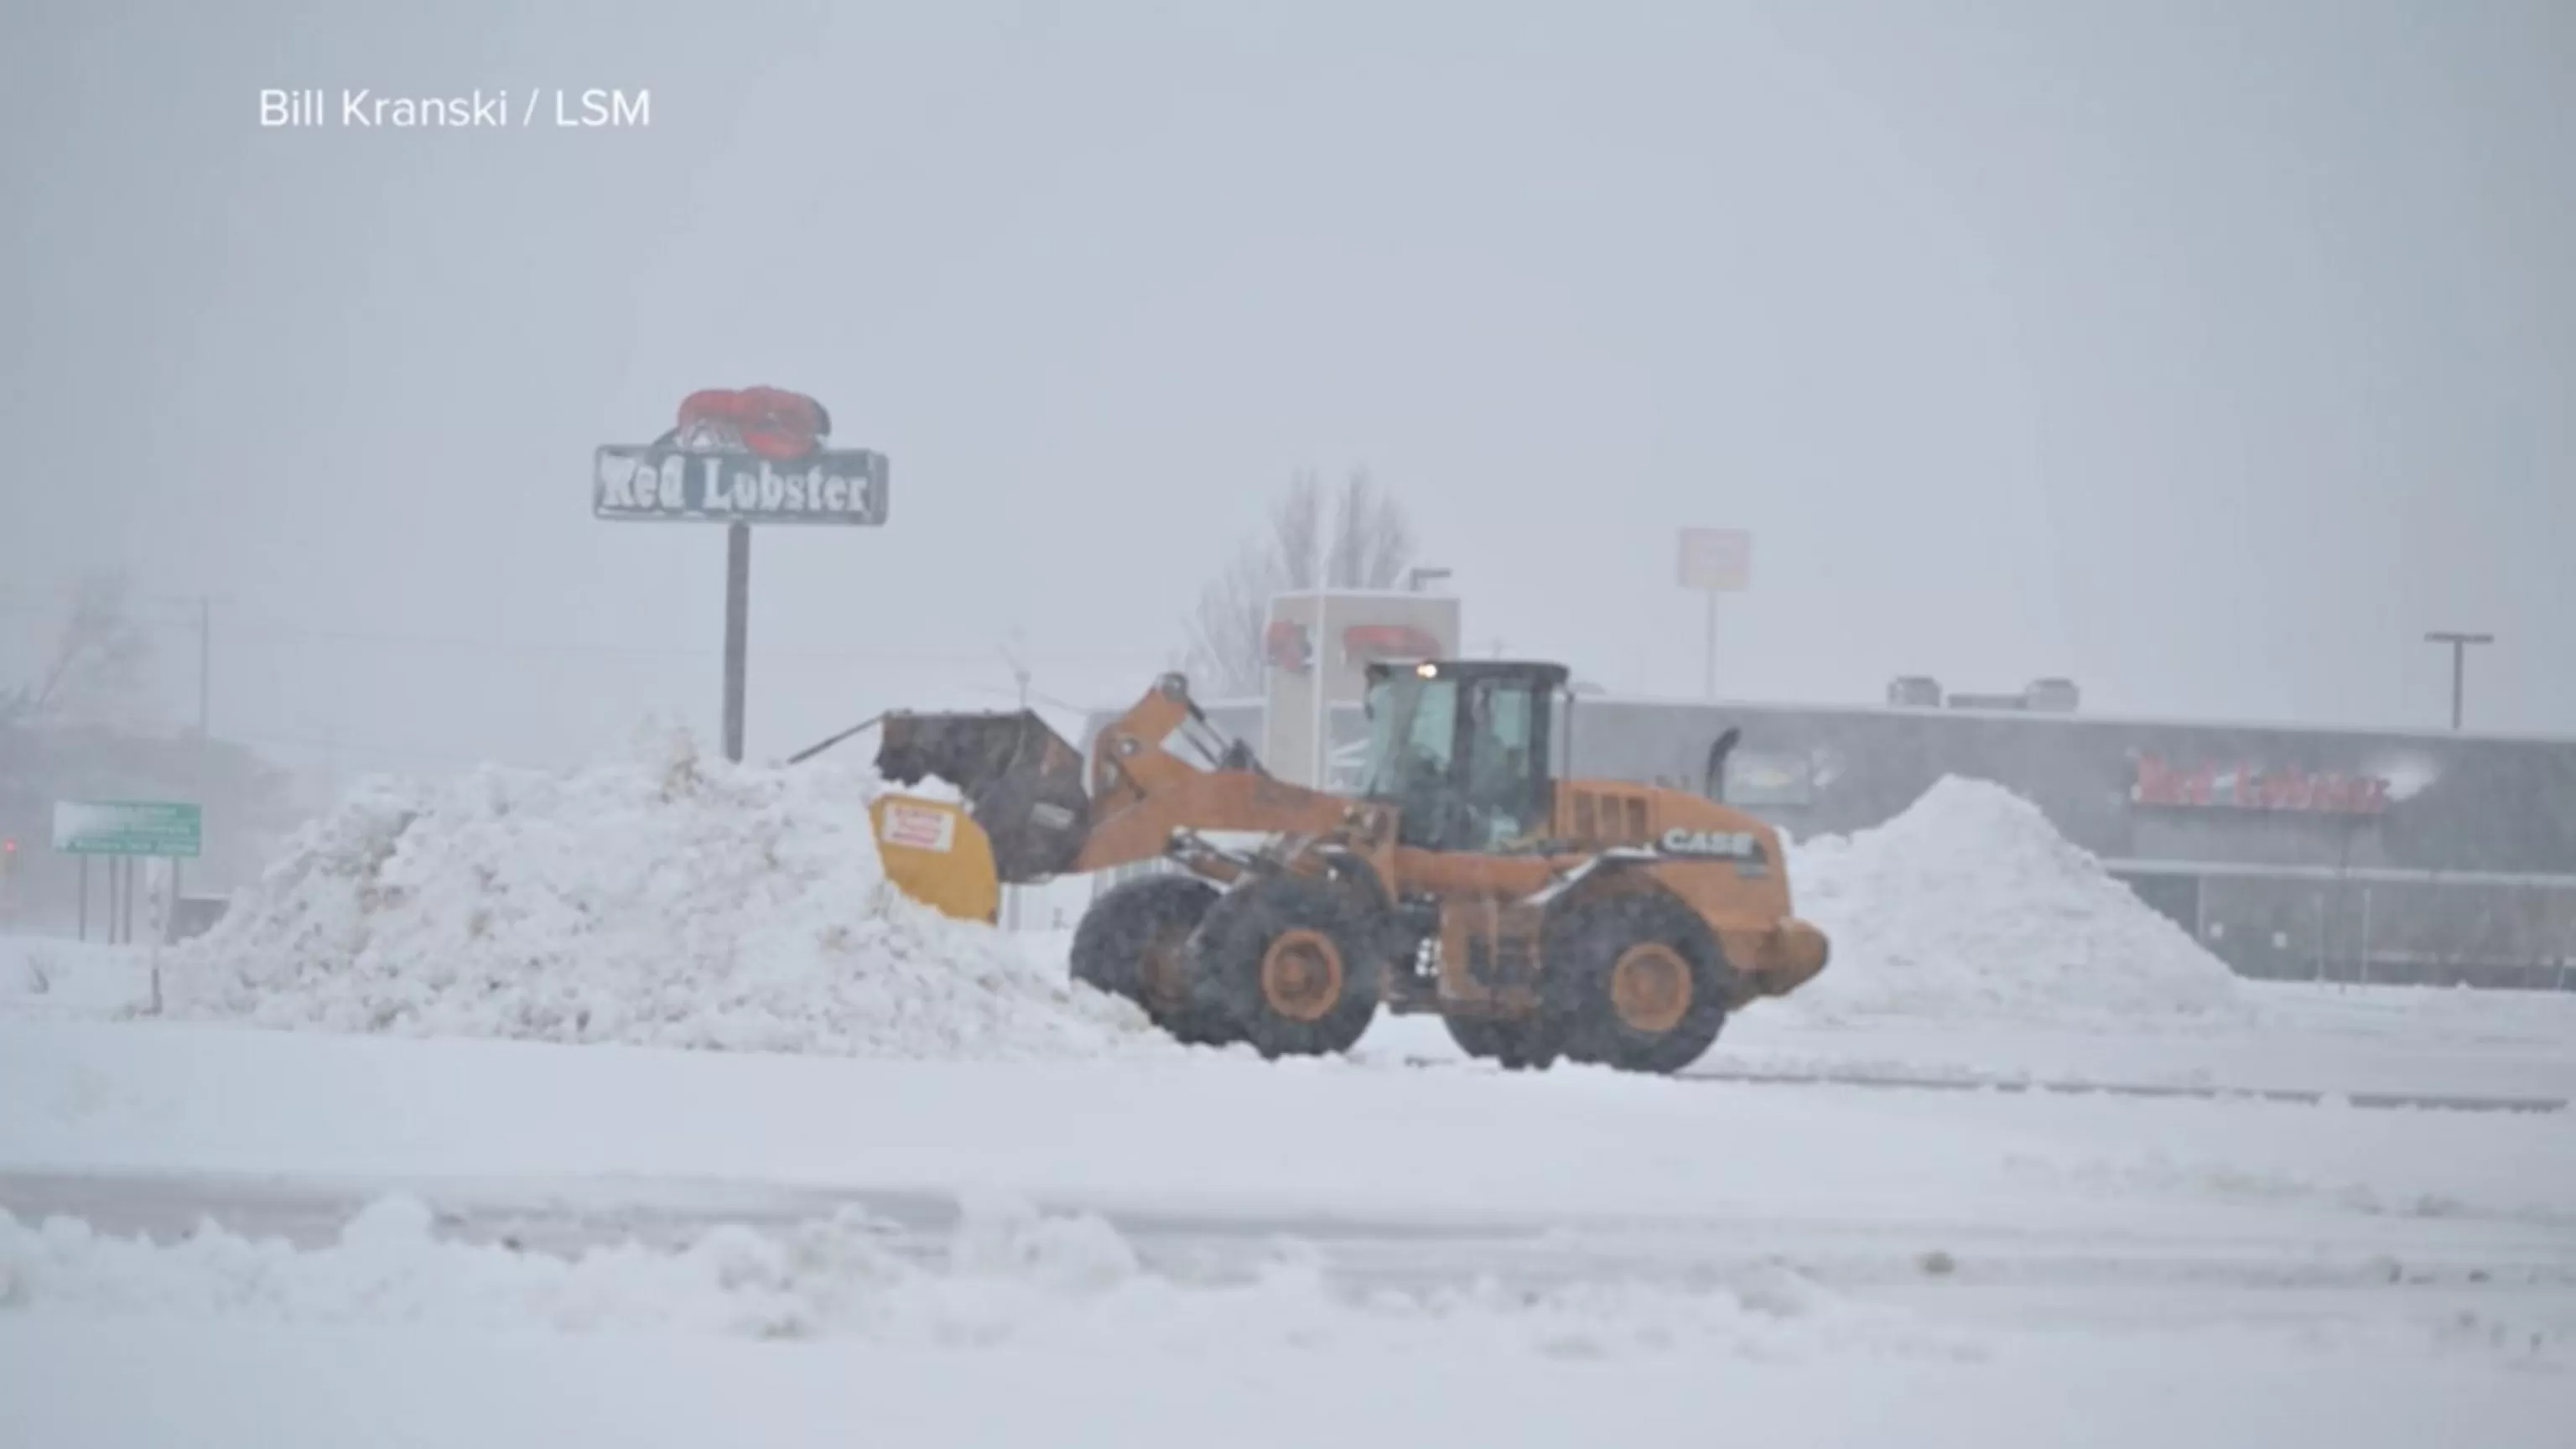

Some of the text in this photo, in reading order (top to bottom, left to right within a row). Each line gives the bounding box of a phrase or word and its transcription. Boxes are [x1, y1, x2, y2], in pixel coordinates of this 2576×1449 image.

[600, 452, 869, 513] Red Lobster
[1663, 827, 1754, 857] CASE
